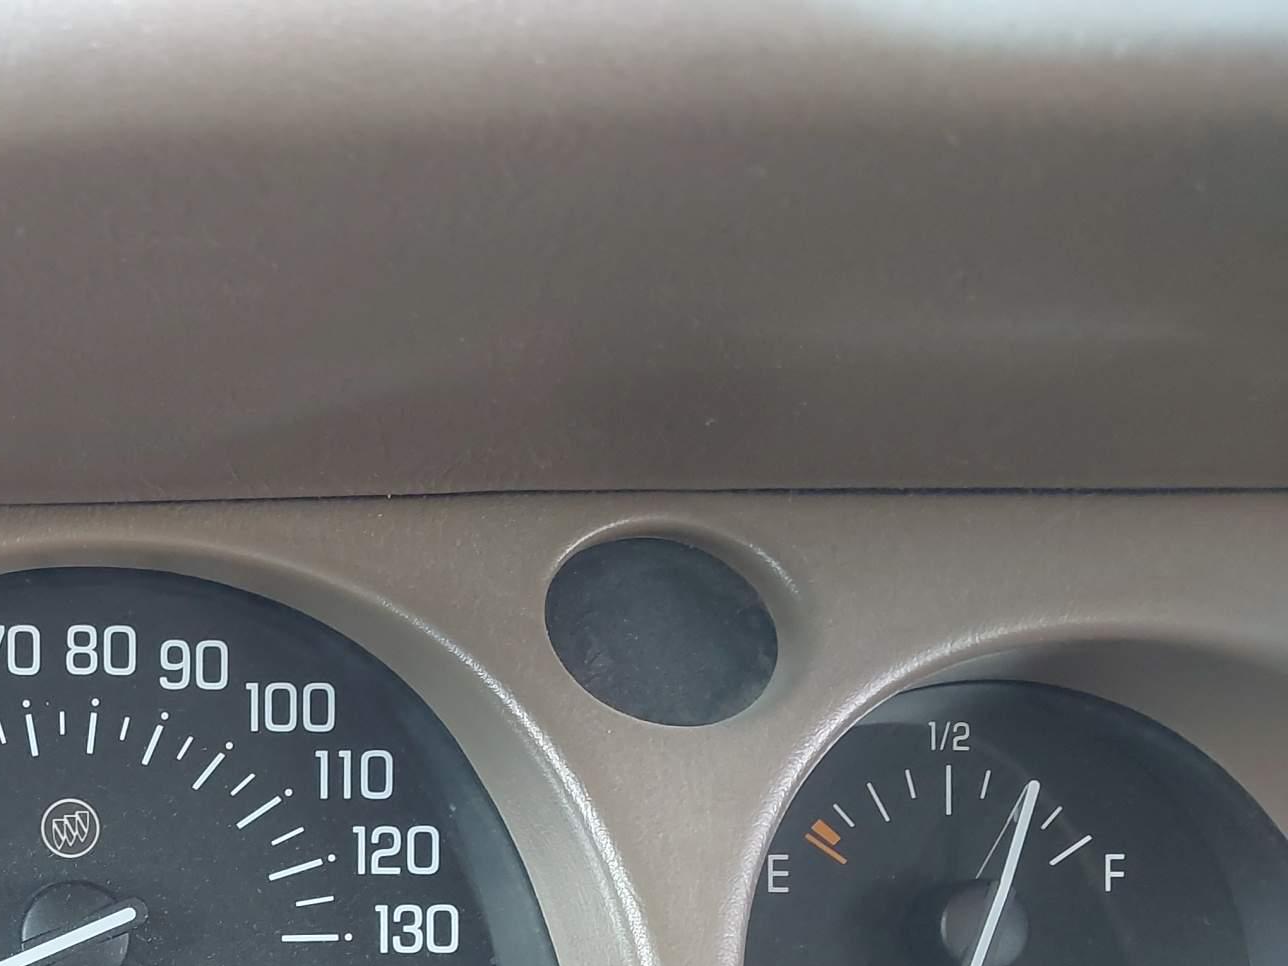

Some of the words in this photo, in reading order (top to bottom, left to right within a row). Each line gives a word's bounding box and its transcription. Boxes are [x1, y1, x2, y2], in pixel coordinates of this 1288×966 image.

[66, 624, 136, 676] 80
[159, 639, 229, 691] 90
[246, 682, 337, 734] 100
[929, 721, 970, 751] 1/2
[315, 749, 393, 801] 110
[352, 824, 439, 876] 120
[767, 855, 789, 893] E
[1104, 854, 1126, 892] F
[374, 904, 459, 955] 130
